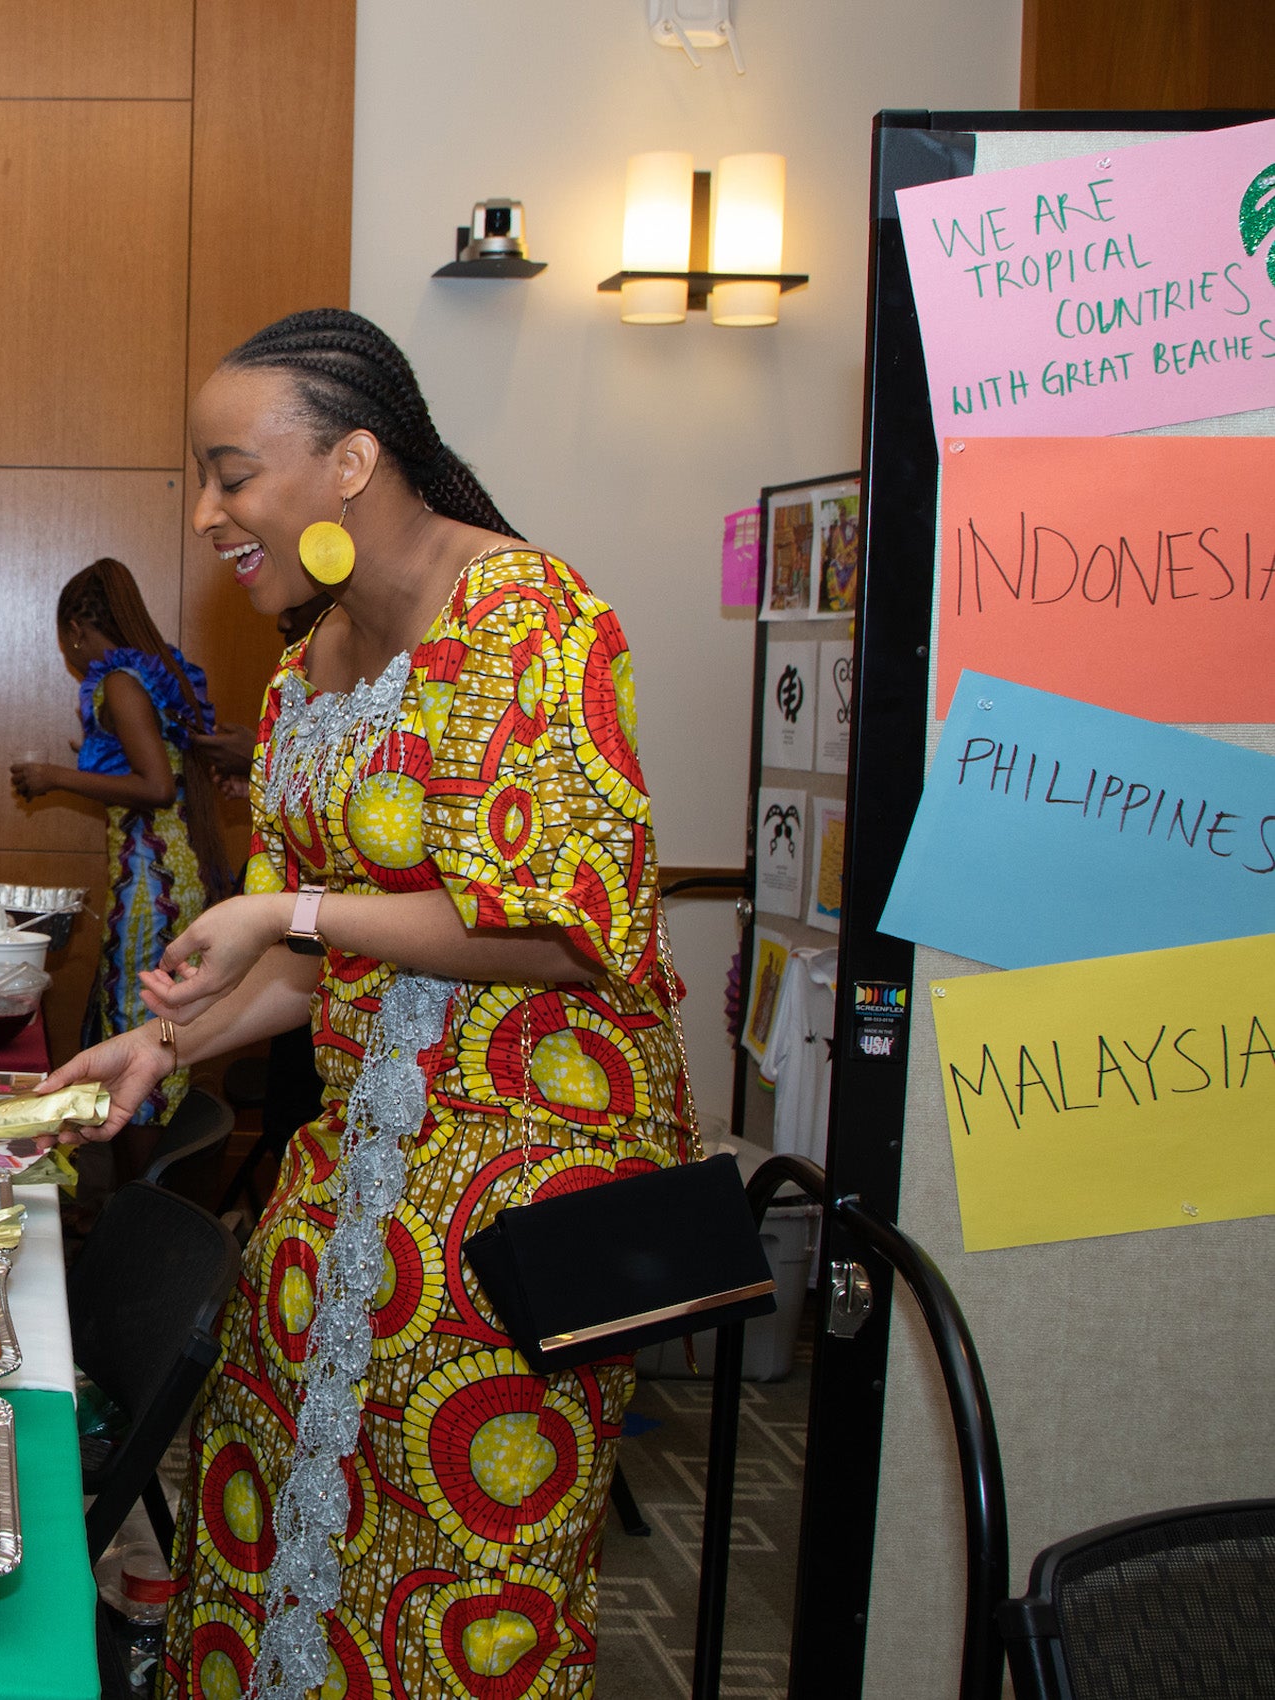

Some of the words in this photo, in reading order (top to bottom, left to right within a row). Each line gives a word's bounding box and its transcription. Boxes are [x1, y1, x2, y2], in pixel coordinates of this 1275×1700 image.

[931, 206, 1016, 258] WE
[1033, 178, 1116, 235] ARE
[963, 233, 1153, 298] TROPICAL
[1055, 262, 1251, 339] COUNTRIES
[952, 369, 1030, 415] WITH
[1041, 353, 1134, 396] GREAT
[1152, 319, 1275, 375] BEACHES
[957, 737, 1275, 874] PHILIPPINES
[855, 1004, 905, 1014] SCREENFLEX
[863, 1035, 891, 1056] USA
[949, 1015, 1275, 1136] MALAYSIA
